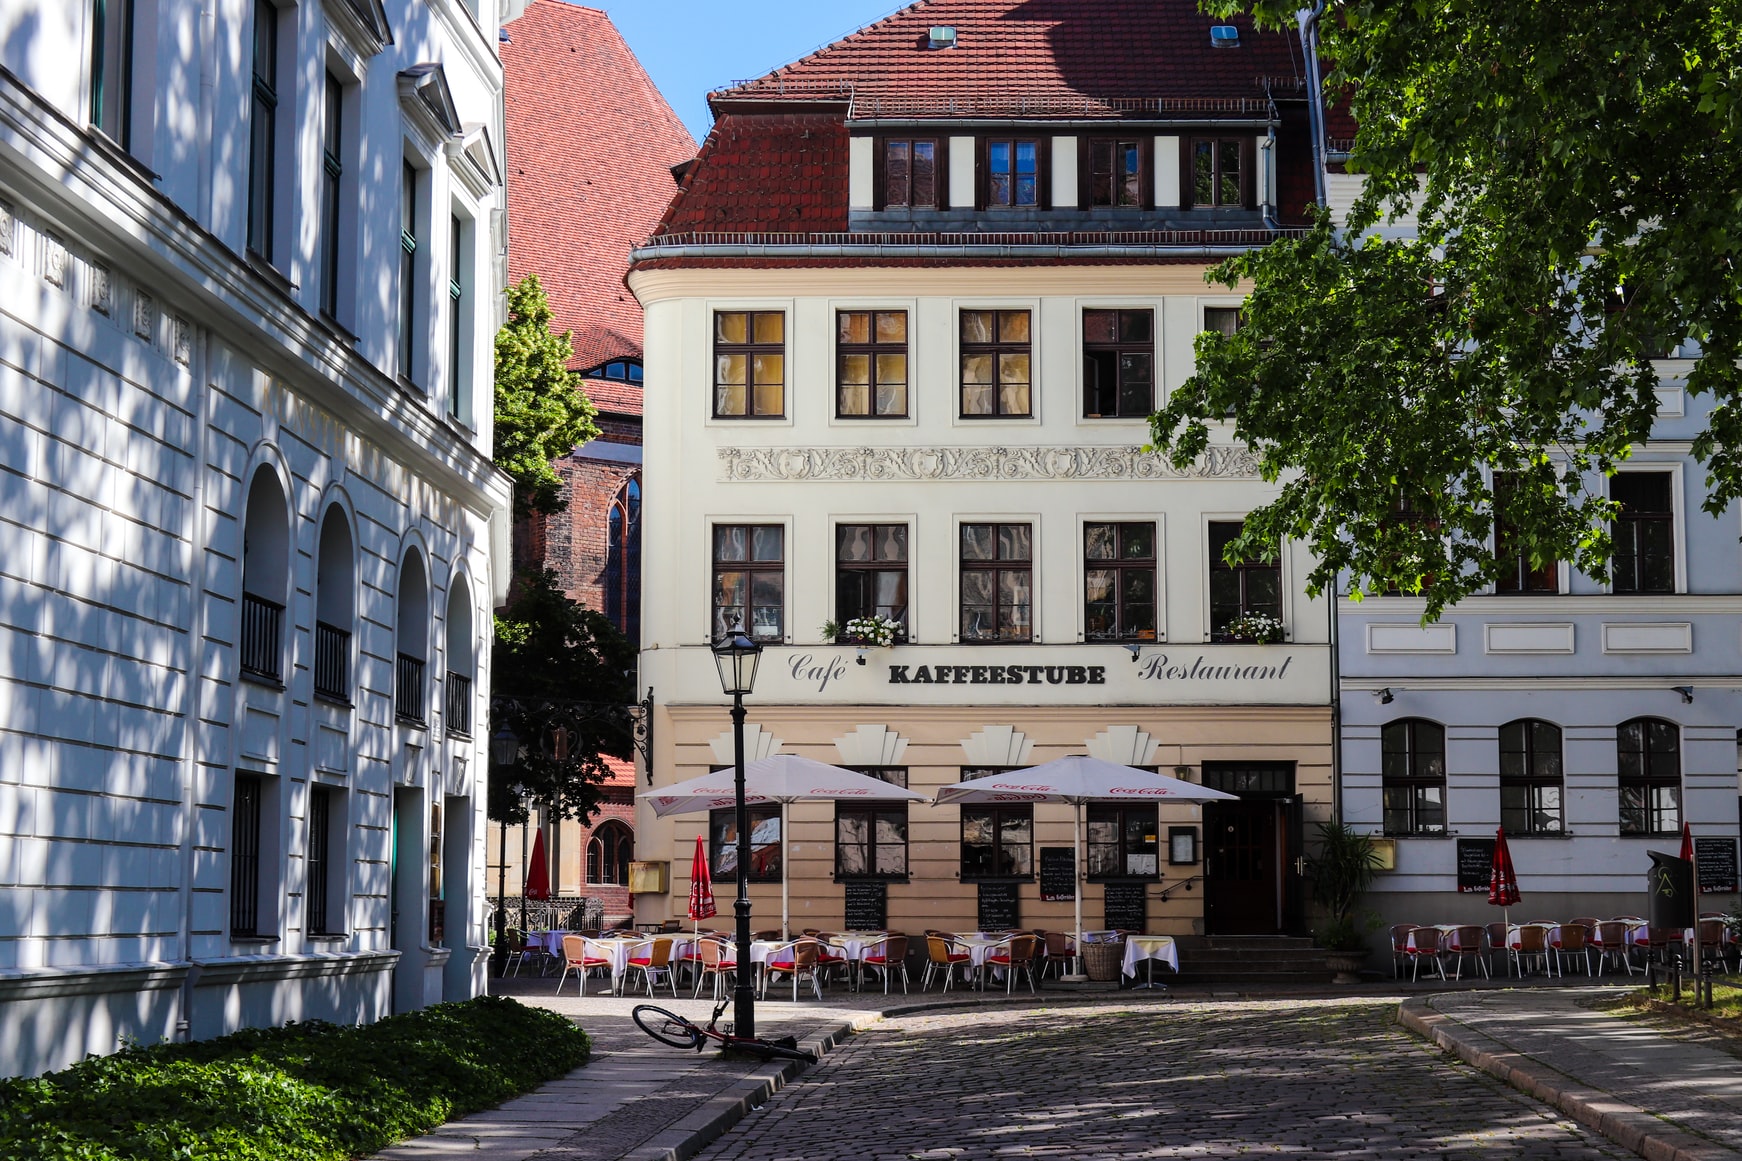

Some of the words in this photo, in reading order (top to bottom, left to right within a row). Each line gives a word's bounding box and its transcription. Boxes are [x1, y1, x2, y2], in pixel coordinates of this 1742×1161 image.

[262, 369, 381, 482] KUNSTHAUS
[788, 653, 848, 692] Café
[889, 665, 1105, 684] KAFFEESTUBE
[1138, 653, 1292, 680] Restaurant
